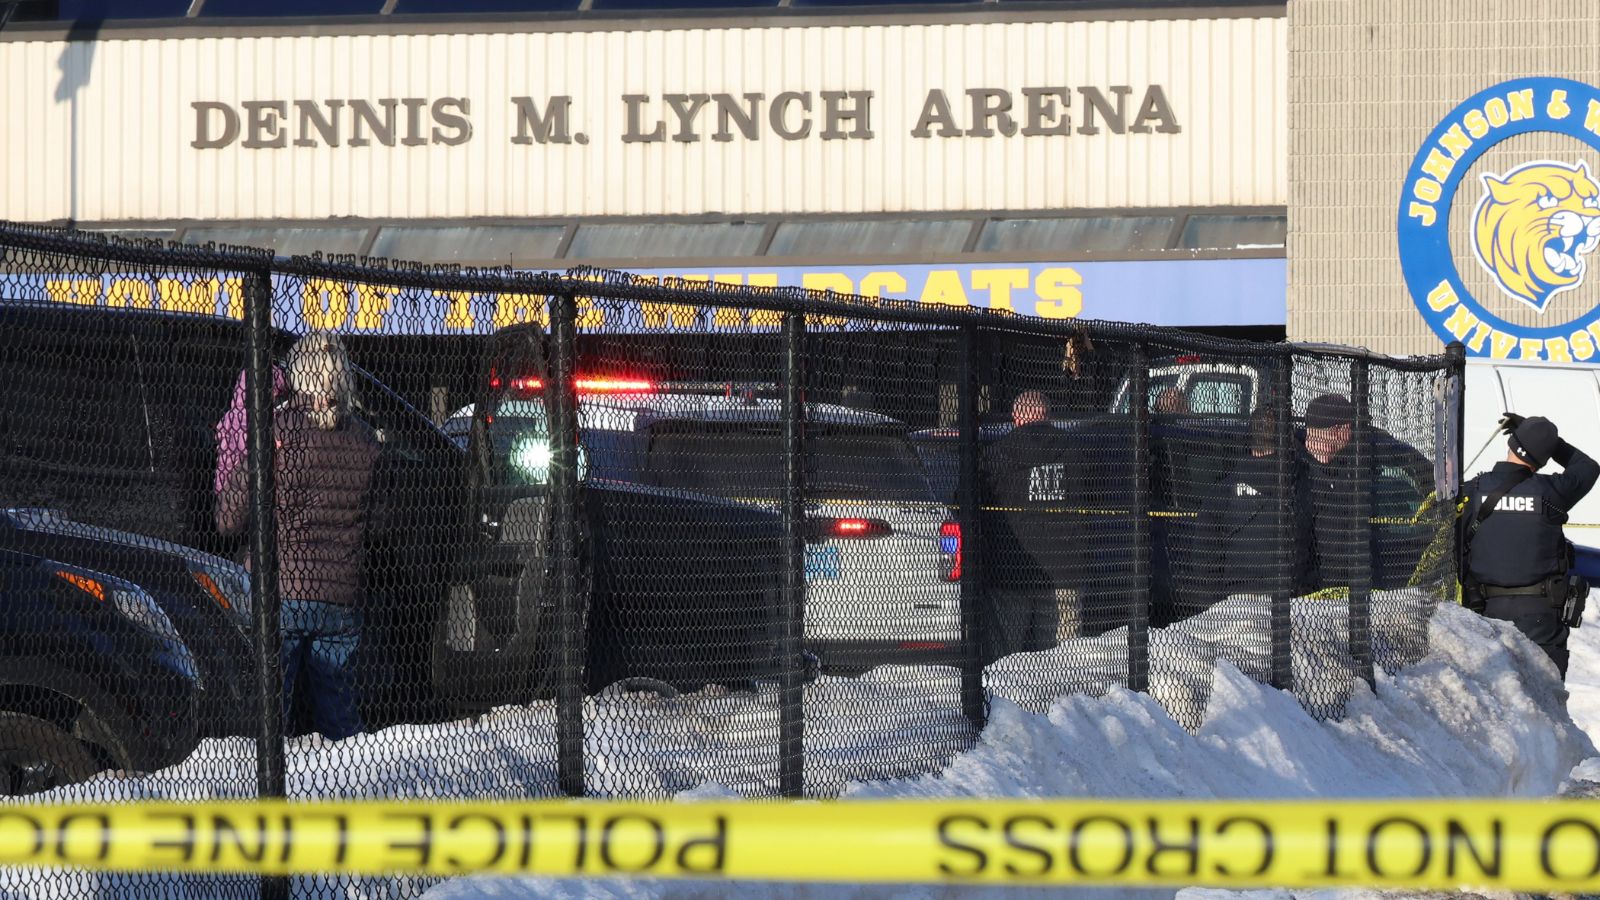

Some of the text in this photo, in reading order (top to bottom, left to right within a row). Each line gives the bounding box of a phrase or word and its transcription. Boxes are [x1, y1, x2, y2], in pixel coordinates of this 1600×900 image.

[190, 84, 1182, 149] DENNIS M. LYNCH ARENA
[1408, 88, 1535, 227] JOHNSON
[303, 277, 400, 329] OF
[632, 267, 1083, 327] WILDCATS
[146, 812, 348, 864] LINE
[380, 812, 728, 874] POLICE
[937, 814, 1275, 877] CROSS
[1304, 817, 1502, 879] NOT
